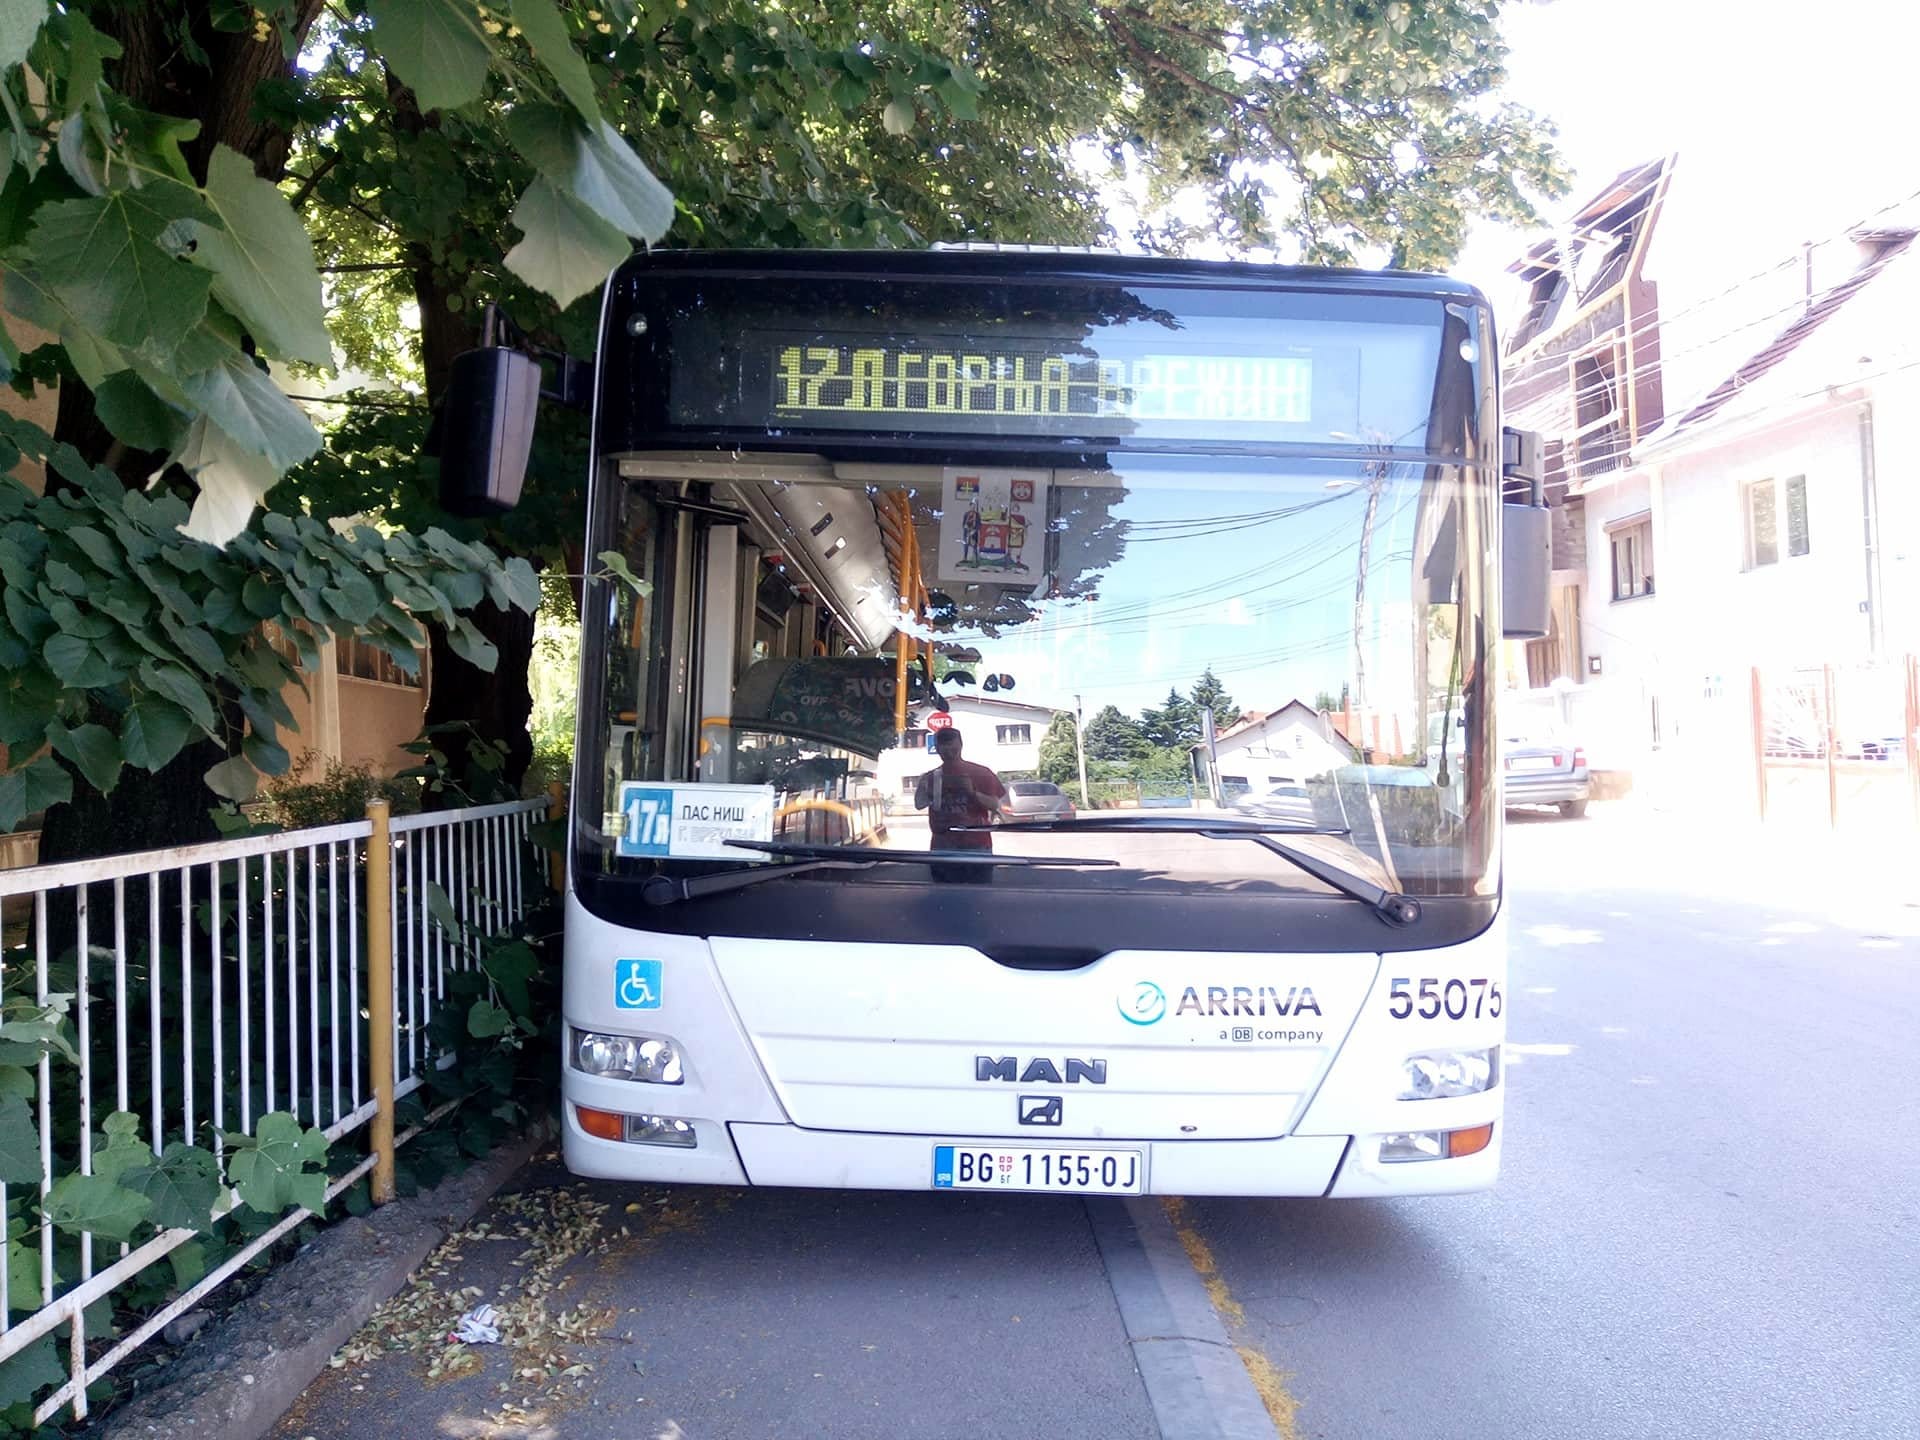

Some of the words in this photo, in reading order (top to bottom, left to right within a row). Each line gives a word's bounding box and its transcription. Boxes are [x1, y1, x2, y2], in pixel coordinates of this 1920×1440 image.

[897, 353, 1069, 415] ГОРЊА
[682, 805, 709, 821] ПАС
[713, 806, 744, 822] НИШ
[1175, 986, 1323, 1017] ARRIVA
[1389, 977, 1502, 1020] 55075
[1219, 1029, 1228, 1040] a
[1234, 1029, 1251, 1040] DB
[1257, 1028, 1324, 1043] company
[975, 1056, 1107, 1084] MAN
[959, 1152, 993, 1183] BG
